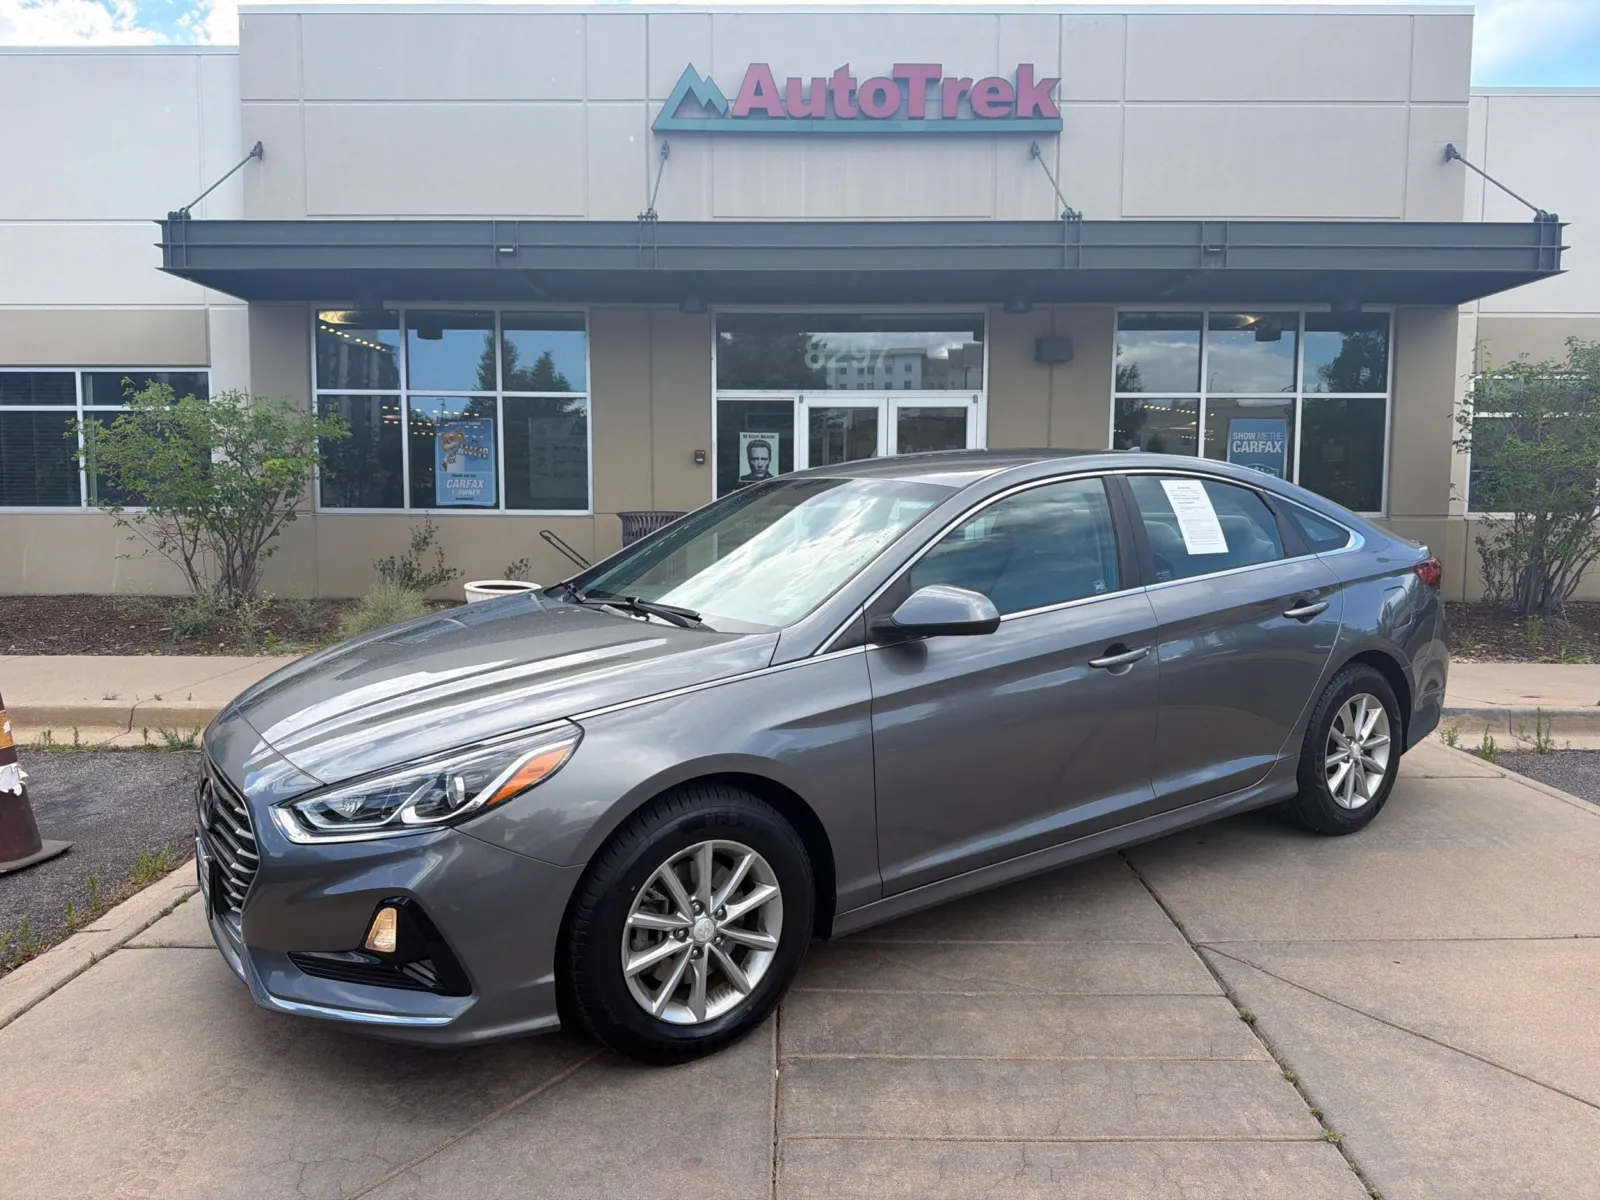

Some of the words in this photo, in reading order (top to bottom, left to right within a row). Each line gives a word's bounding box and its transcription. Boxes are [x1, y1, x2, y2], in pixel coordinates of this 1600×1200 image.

[731, 62, 1062, 119] AutoTrek
[804, 336, 889, 369] 8297
[1233, 432, 1256, 440] SHOW
[1257, 432, 1269, 440] ME
[1269, 432, 1283, 440] THE
[1233, 440, 1283, 453] CARFAX
[446, 479, 485, 489] CARFAX
